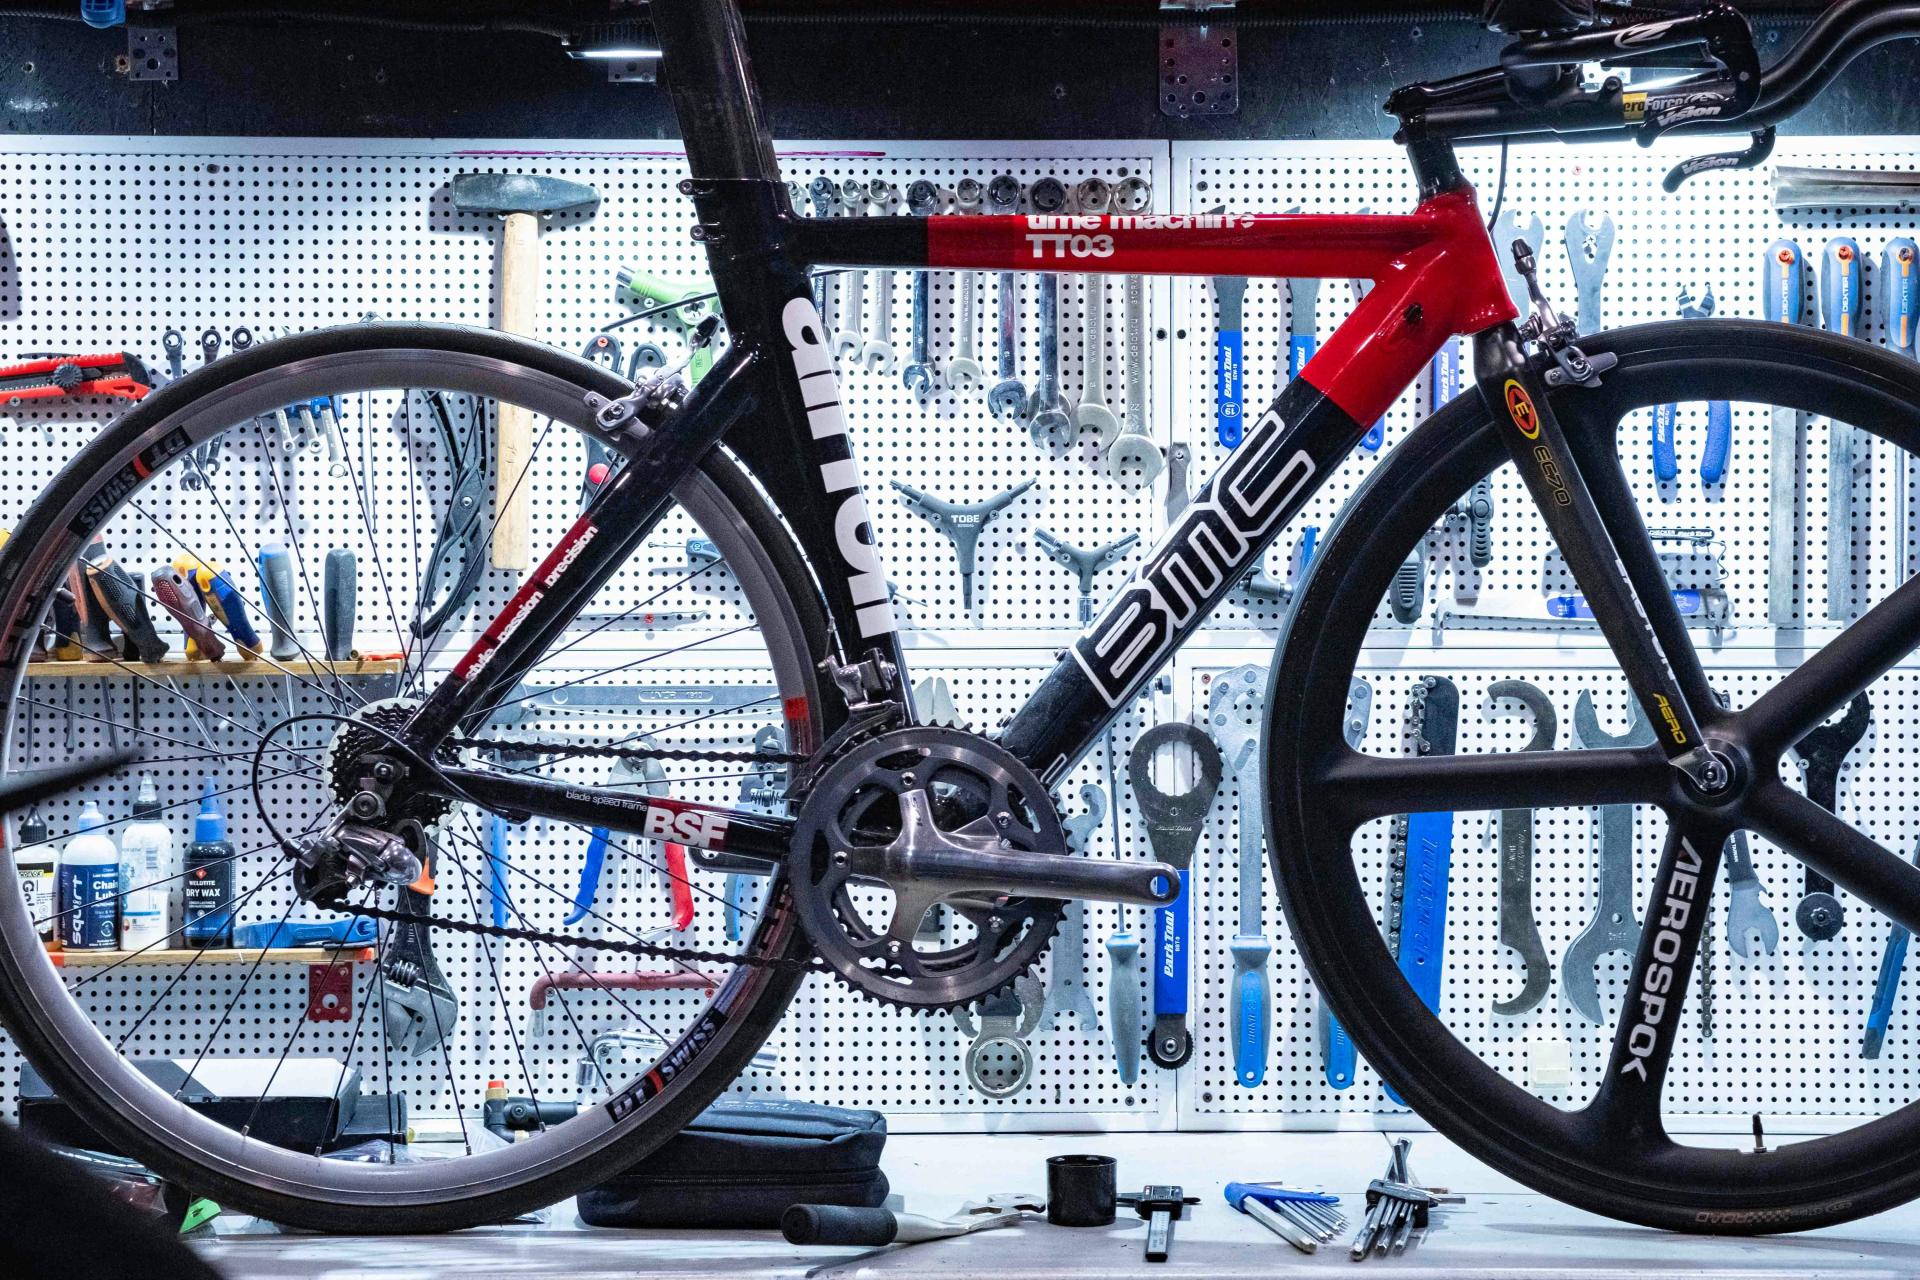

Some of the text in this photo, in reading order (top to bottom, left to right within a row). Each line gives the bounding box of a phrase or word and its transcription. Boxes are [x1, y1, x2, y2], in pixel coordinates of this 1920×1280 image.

[1657, 105, 1721, 127] Vision
[1682, 156, 1739, 175] Vision
[1025, 234, 1115, 258] TT03
[1781, 279, 1789, 315] DEXTER
[1841, 275, 1849, 312] DEXTER
[1223, 345, 1232, 399] Park Tool
[1534, 445, 1572, 506] EC70
[951, 514, 980, 524] TOBE
[544, 525, 599, 588] precision
[1653, 692, 1687, 744] AERO
[566, 789, 648, 812] blade speed frame
[644, 805, 729, 849] BSF
[186, 888, 221, 897] DRY WAX
[1163, 910, 1175, 978] Park Tool
[661, 1015, 717, 1081] SWISS
